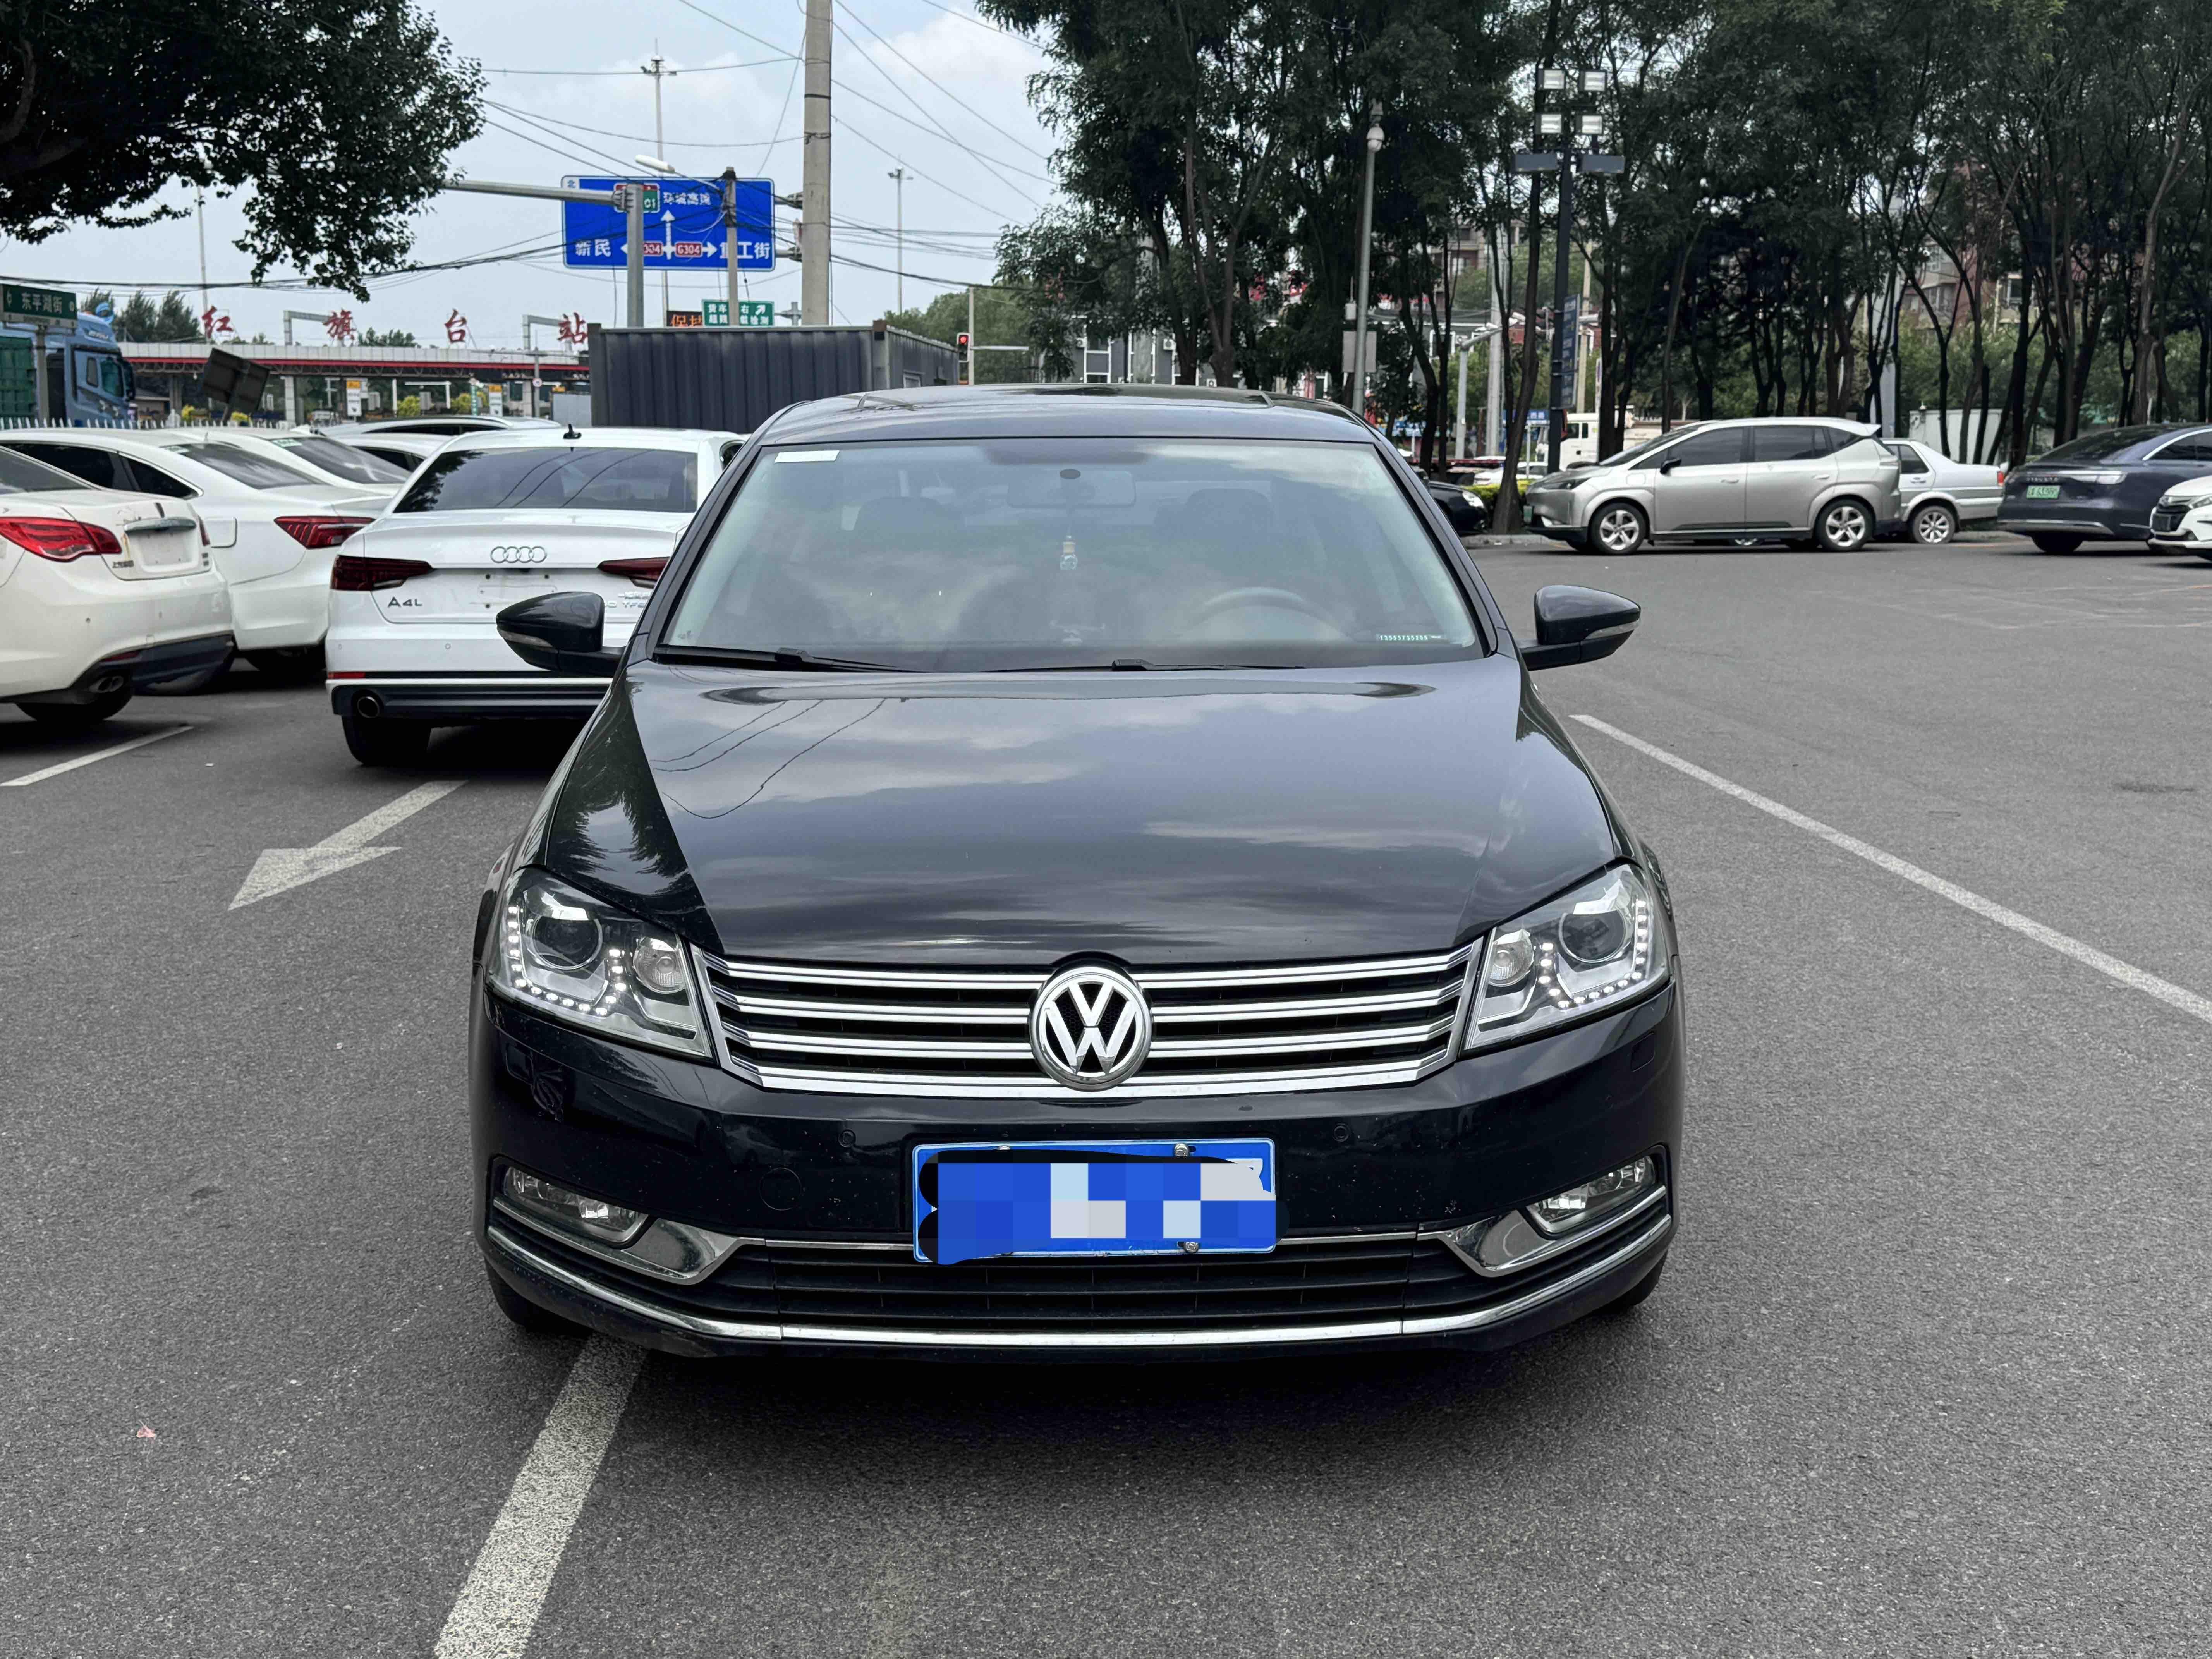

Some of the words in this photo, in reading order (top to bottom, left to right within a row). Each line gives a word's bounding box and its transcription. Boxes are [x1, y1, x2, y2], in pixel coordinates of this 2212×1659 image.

[575, 238, 611, 257] 新民
[644, 244, 660, 255] 304
[677, 245, 701, 255] G304
[388, 596, 422, 608] A4L
